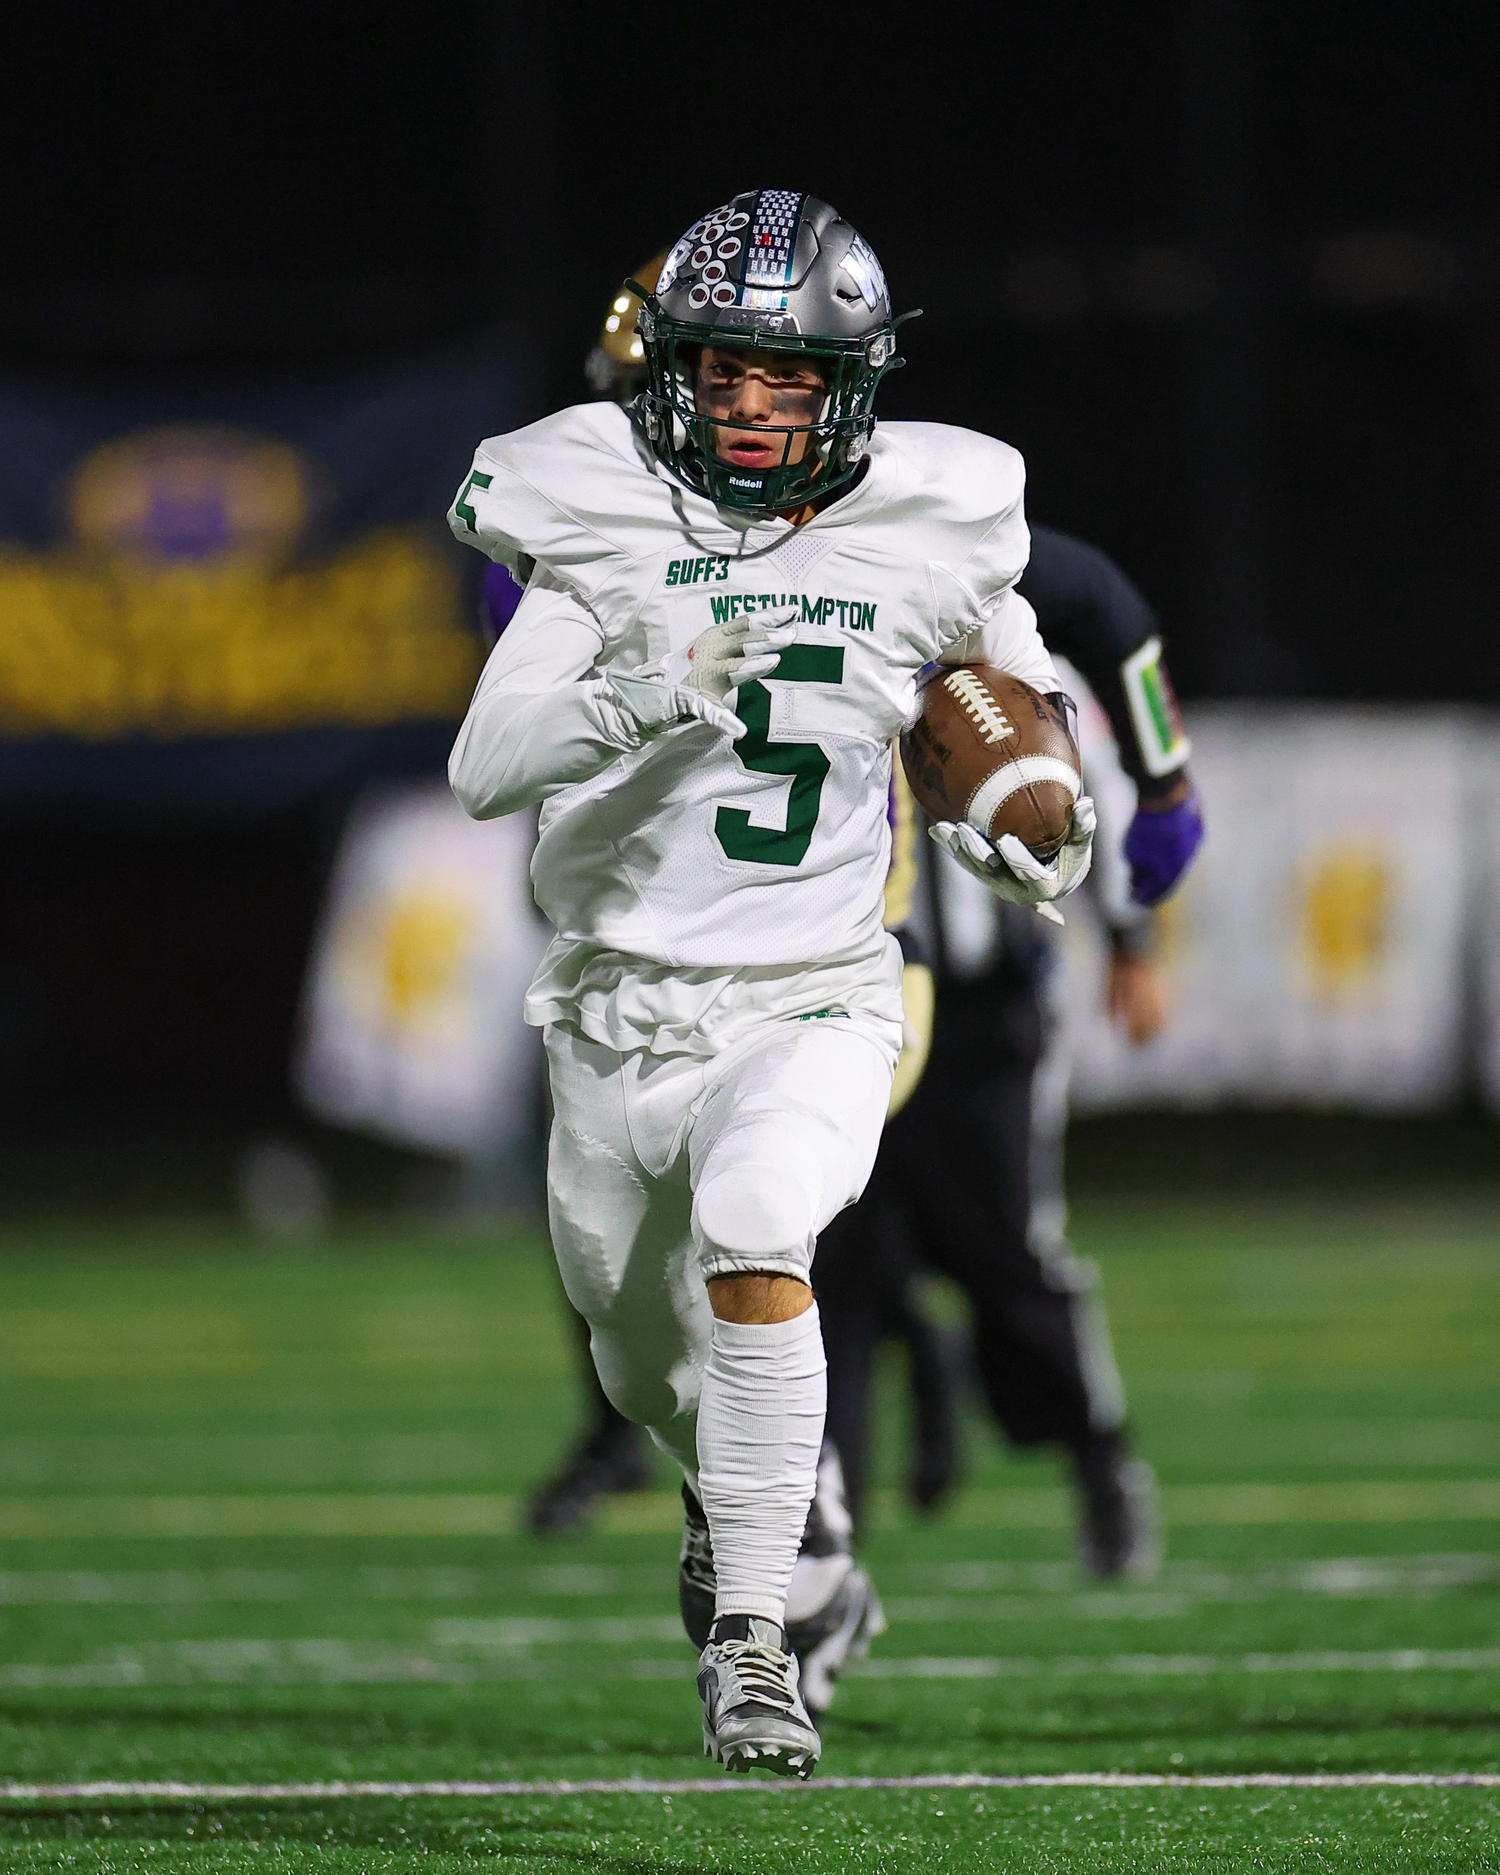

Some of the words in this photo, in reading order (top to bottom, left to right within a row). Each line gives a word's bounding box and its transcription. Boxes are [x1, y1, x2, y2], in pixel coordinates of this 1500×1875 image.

[729, 476, 763, 489] Riddell
[666, 556, 730, 586] SUFF3
[714, 644, 846, 867] 5
